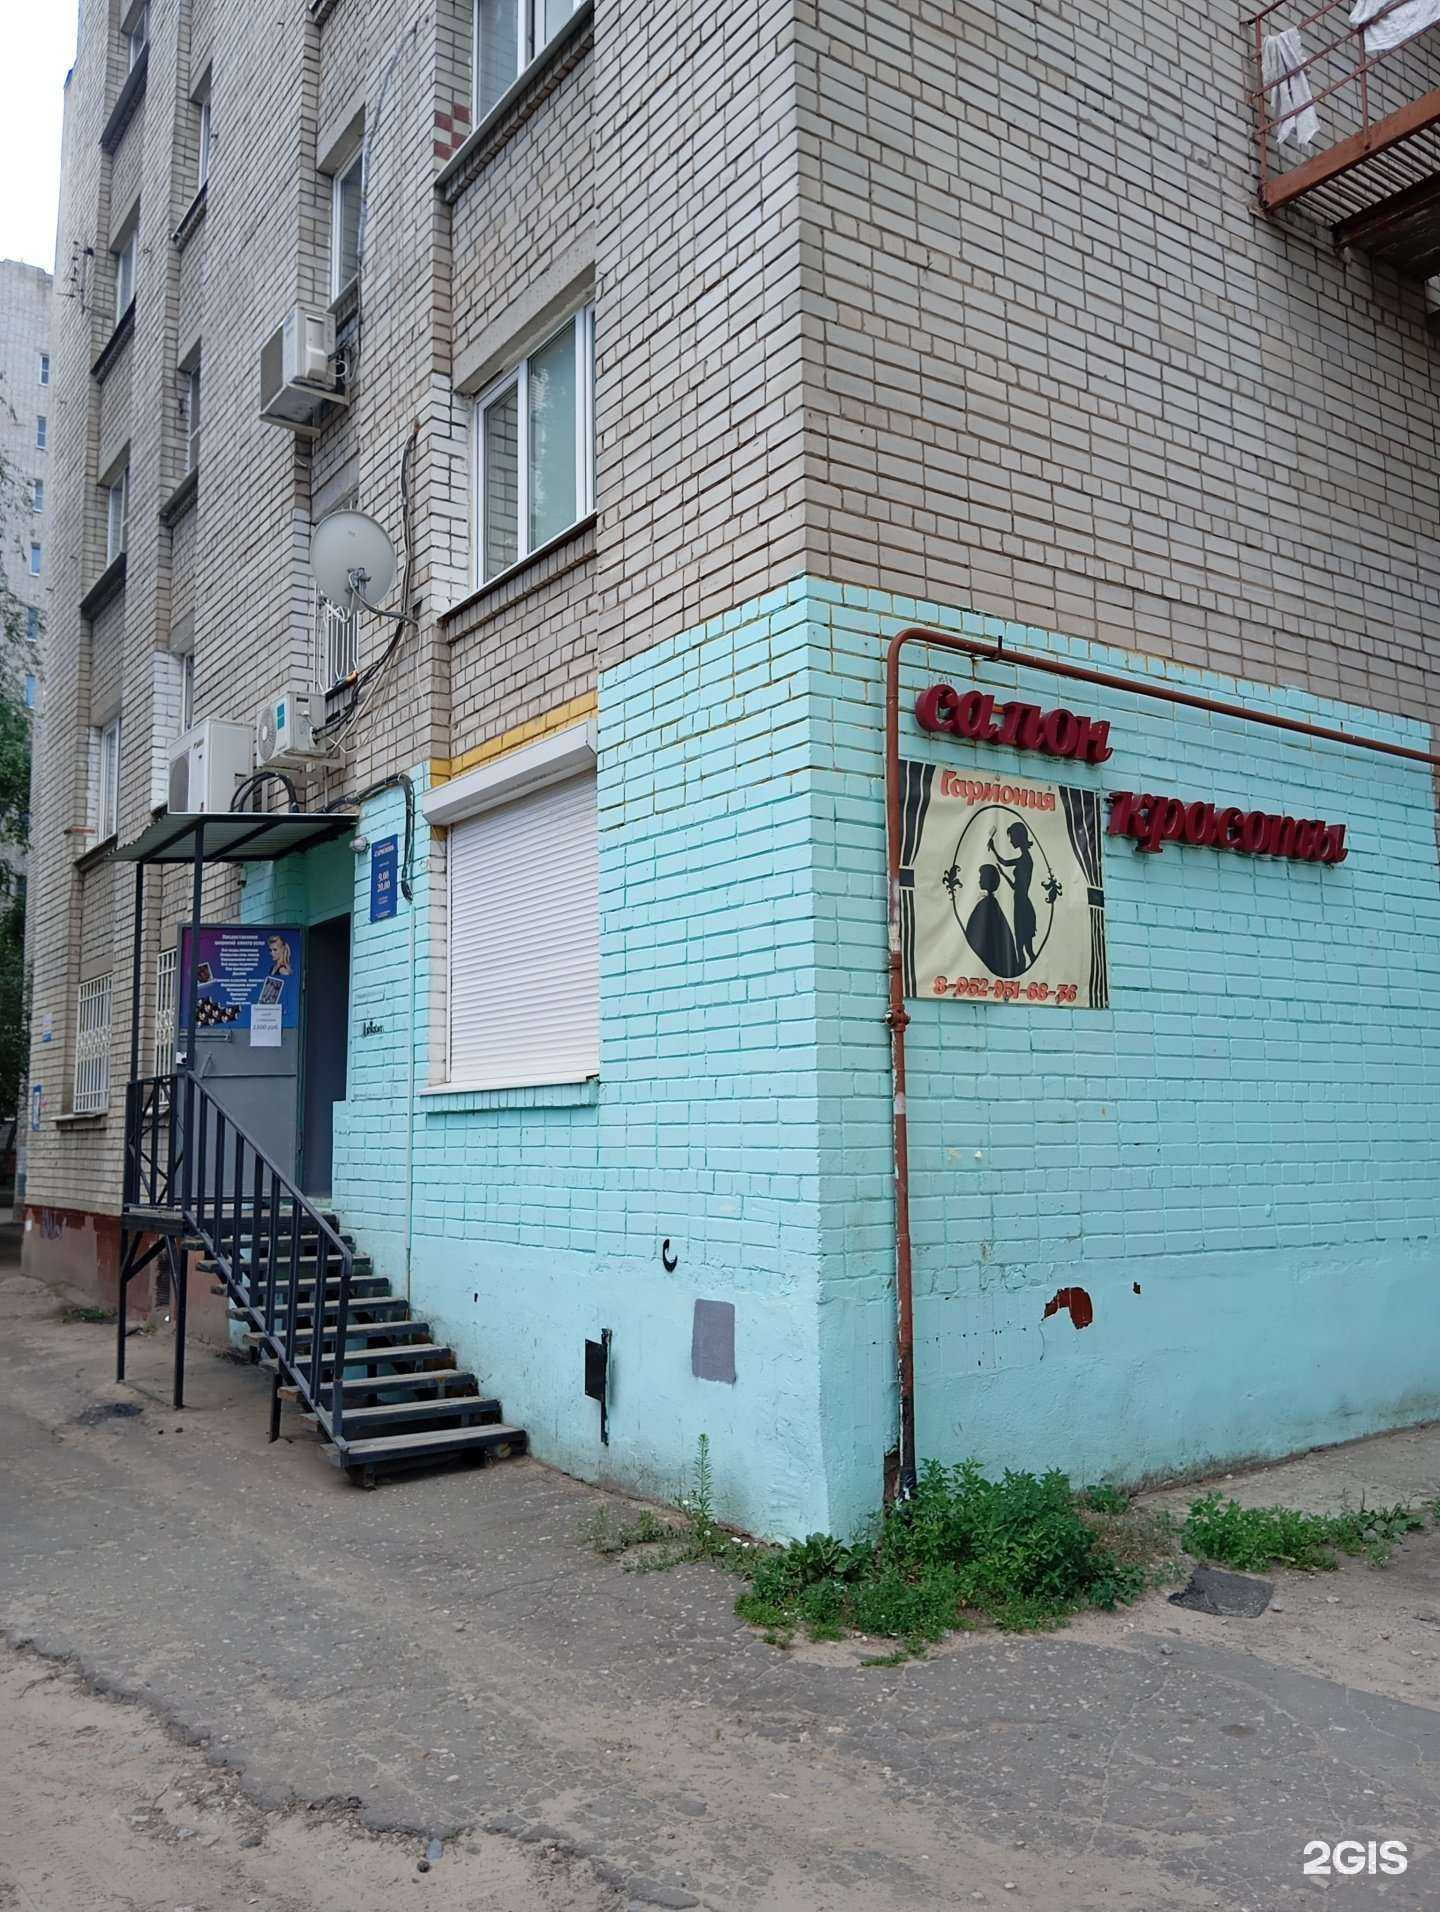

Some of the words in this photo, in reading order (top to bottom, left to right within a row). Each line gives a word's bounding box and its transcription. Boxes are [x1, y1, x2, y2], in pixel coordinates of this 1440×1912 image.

[914, 683, 1113, 764] салон
[940, 770, 1056, 812] Гармония
[1107, 790, 1348, 864] красоты
